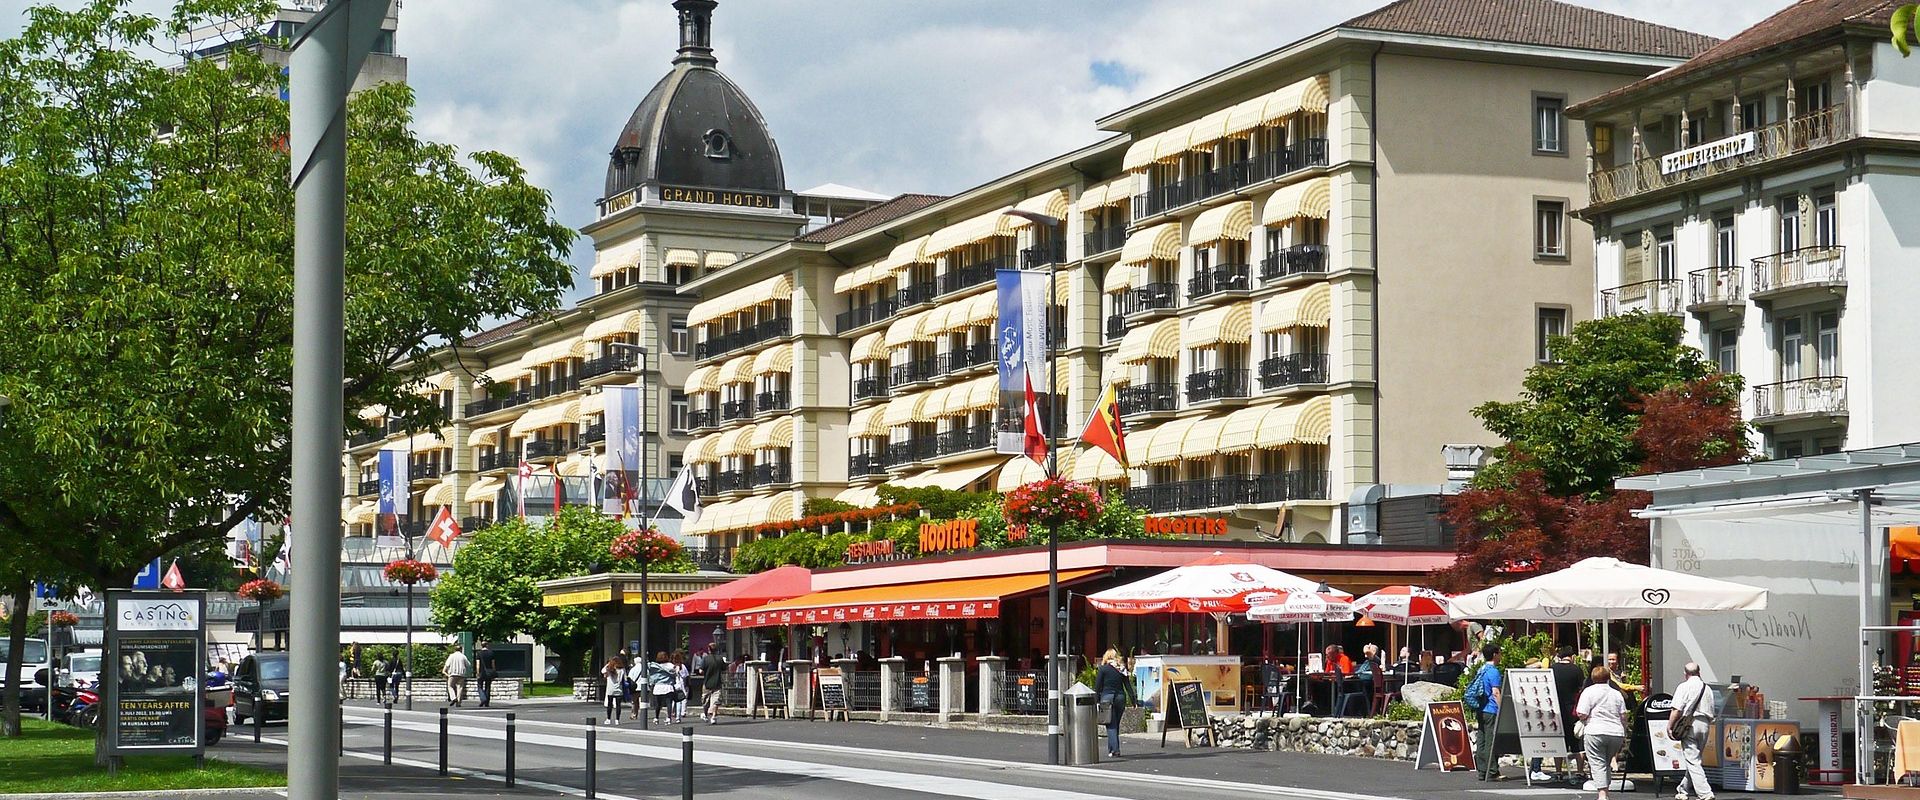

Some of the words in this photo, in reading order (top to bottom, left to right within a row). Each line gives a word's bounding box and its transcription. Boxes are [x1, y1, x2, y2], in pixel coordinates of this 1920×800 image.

[1667, 137, 1747, 171] SCHWEIZERHOF
[663, 188, 715, 204] GRAND
[723, 193, 774, 208] HOTEL
[1145, 515, 1227, 535] HOOTERS
[848, 540, 897, 557] RESTAURANT
[919, 518, 978, 552] HOOTERS
[1008, 524, 1027, 541] BAR
[123, 610, 189, 621] CASINO
[1432, 706, 1460, 715] MAGNUM
[1757, 728, 1778, 747] Art
